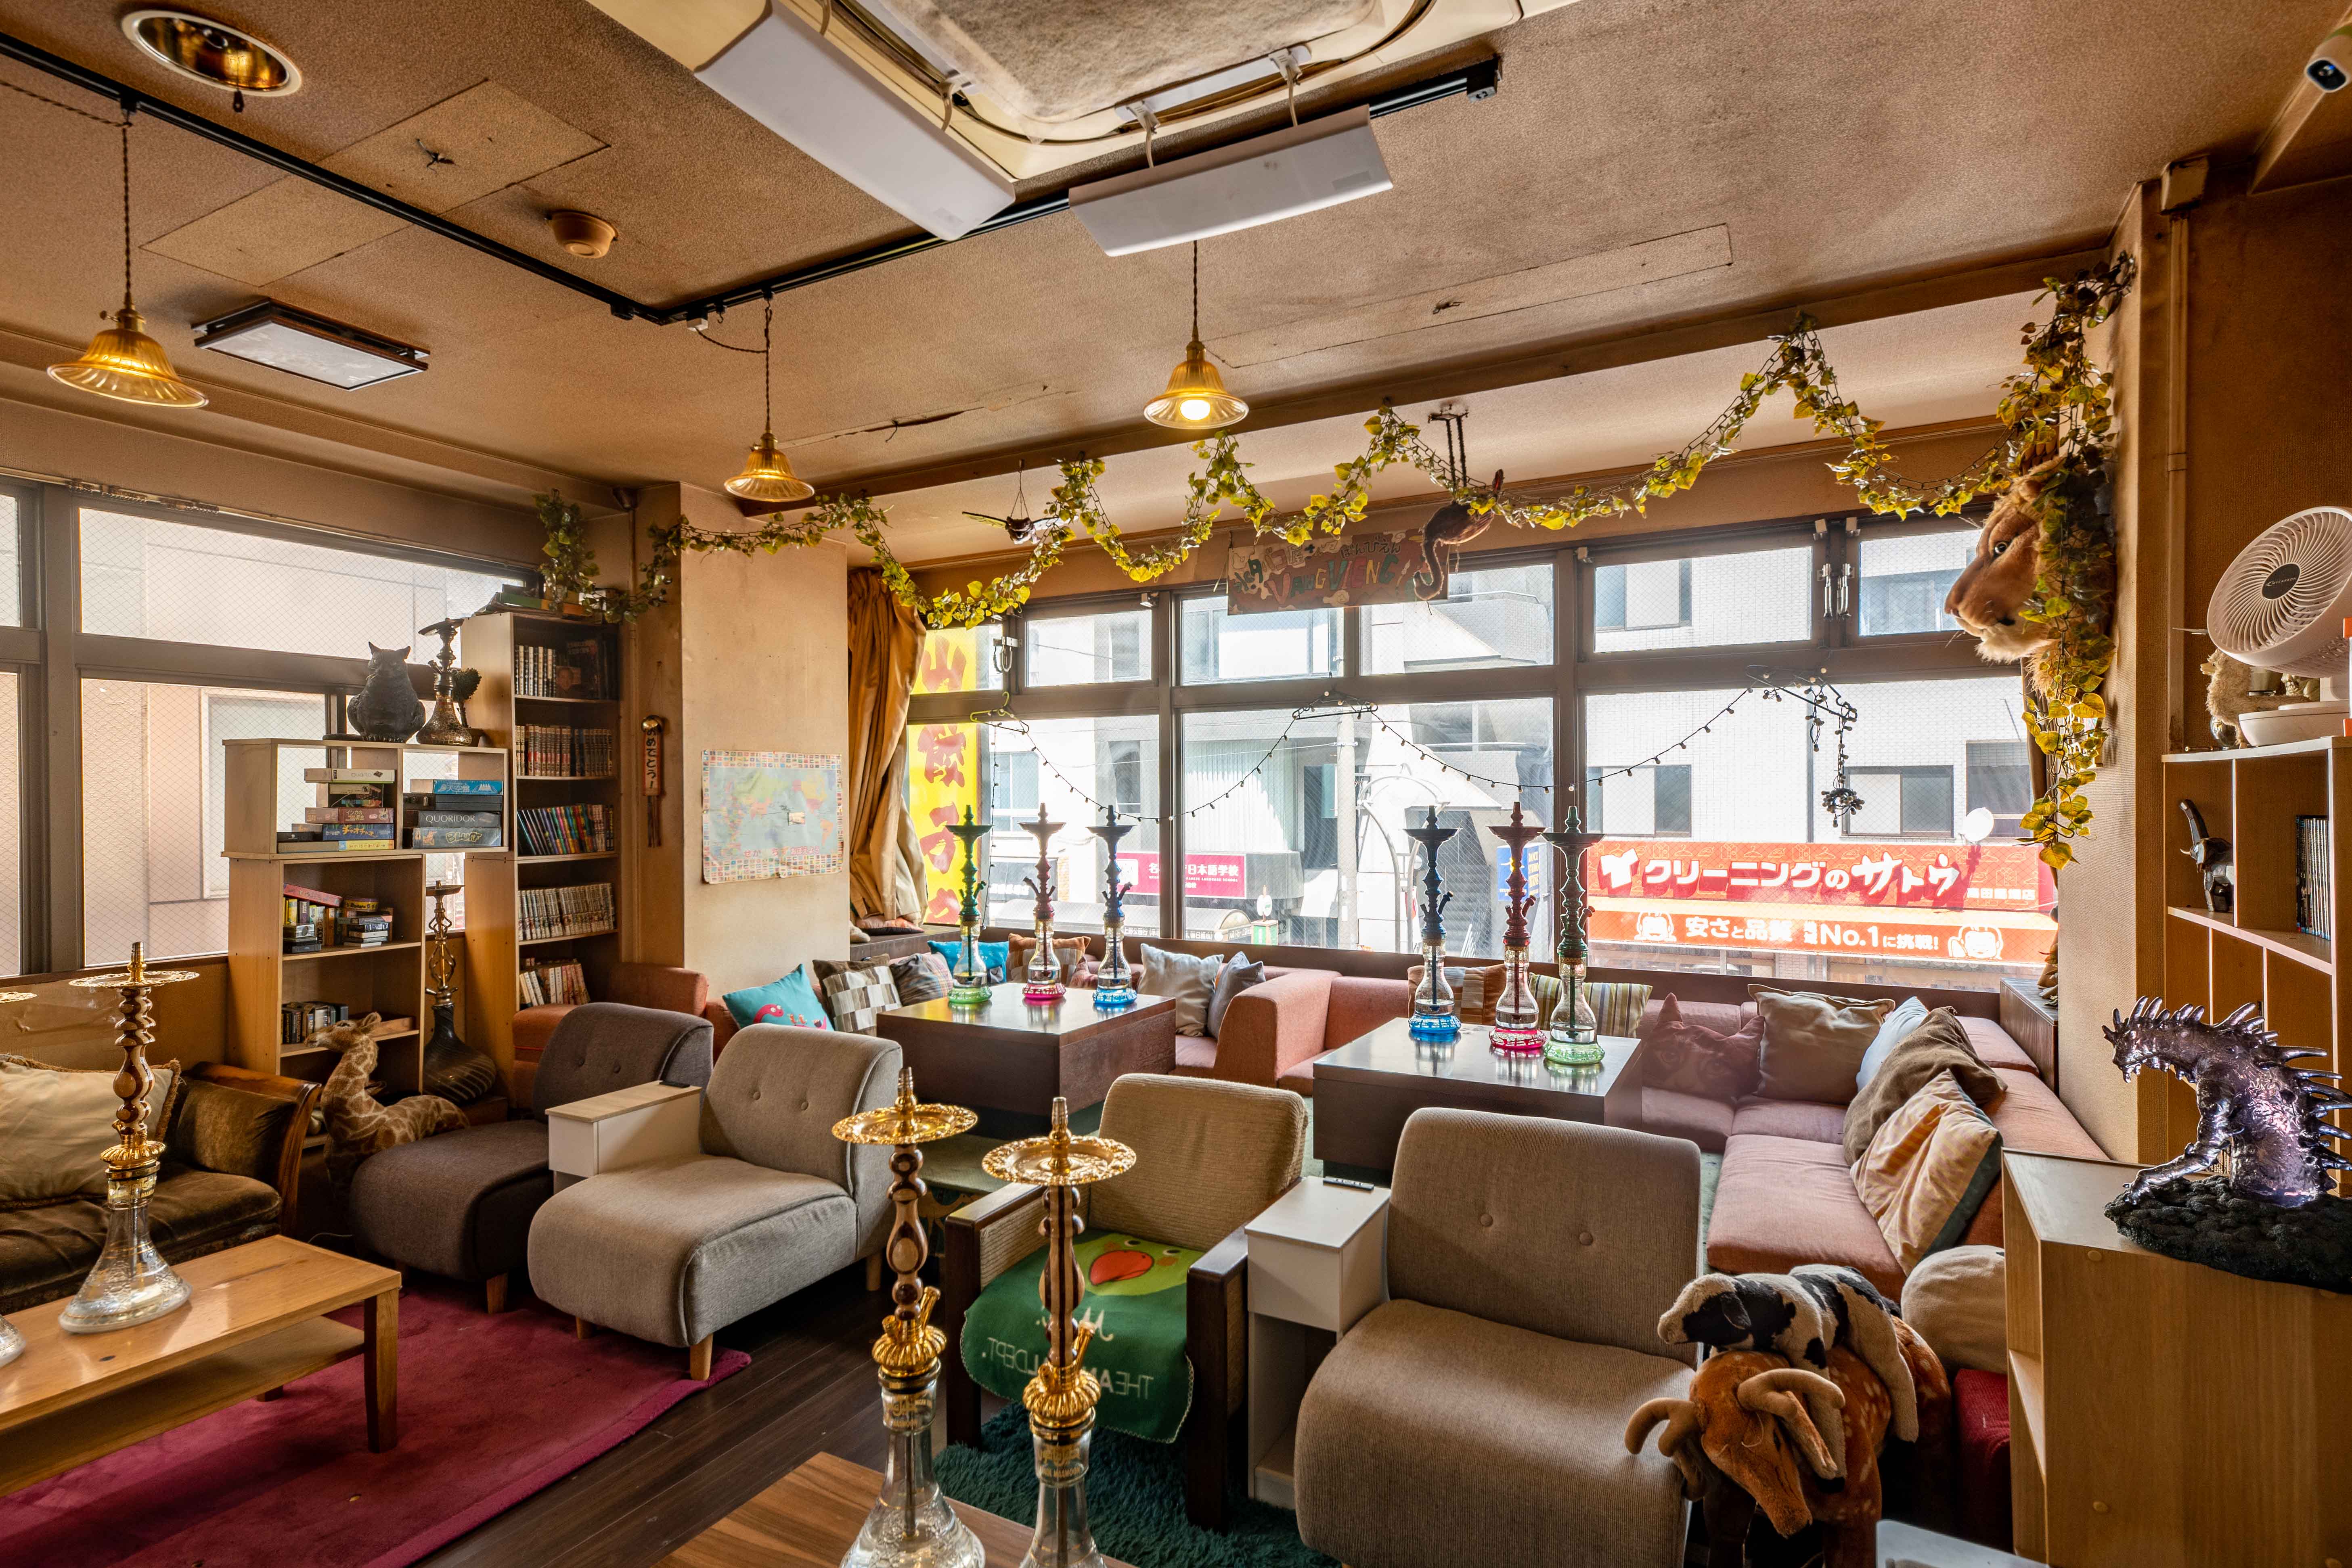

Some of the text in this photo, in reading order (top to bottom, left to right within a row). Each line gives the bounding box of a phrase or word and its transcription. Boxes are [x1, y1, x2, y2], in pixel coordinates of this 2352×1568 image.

[1340, 533, 1401, 558] ばんびえん
[425, 814, 475, 824] QUORIDOR
[445, 831, 483, 844] BLUFF
[1644, 852, 1960, 896] クリーニングのサトウ
